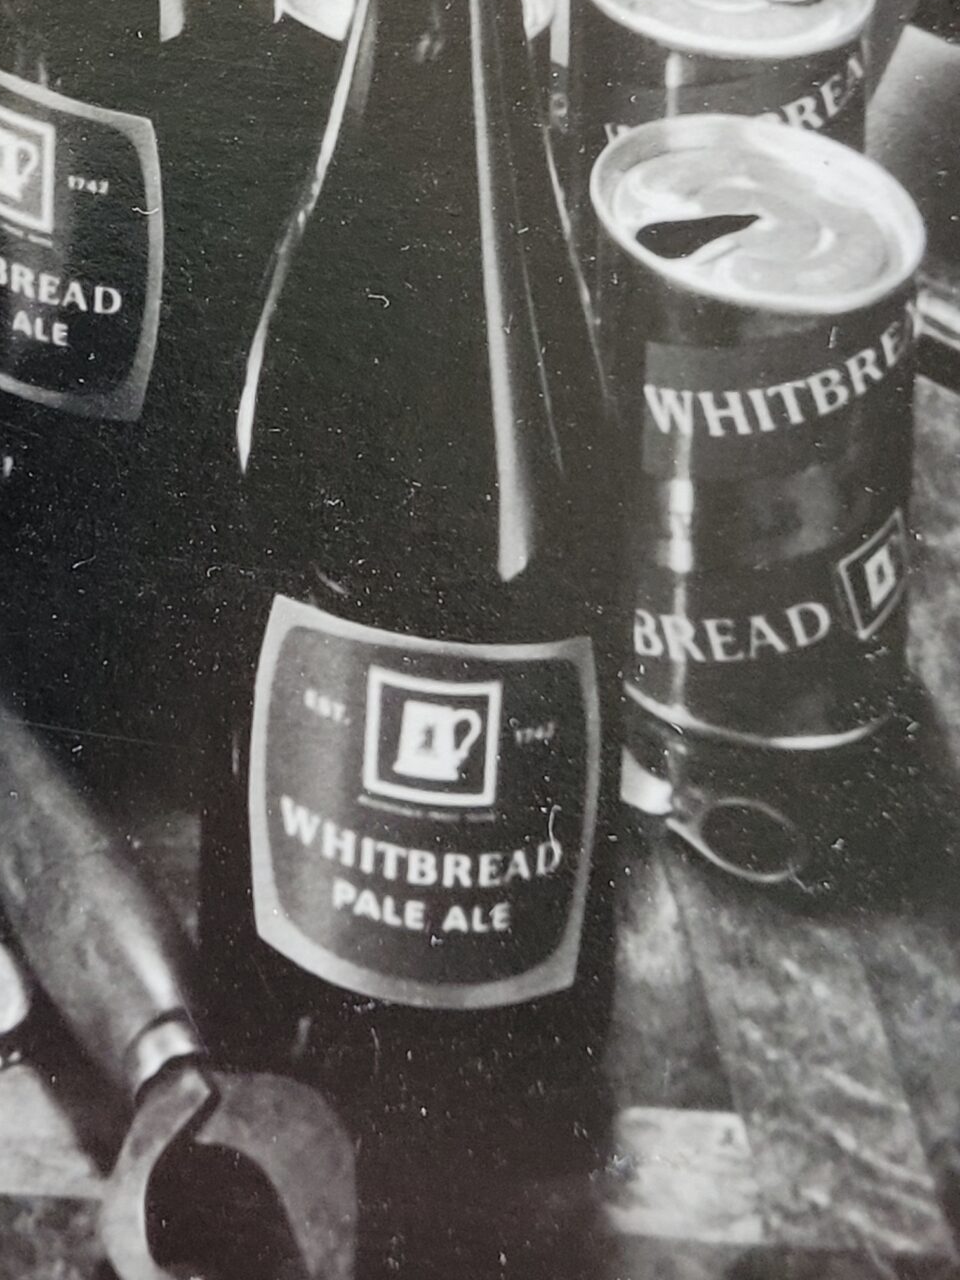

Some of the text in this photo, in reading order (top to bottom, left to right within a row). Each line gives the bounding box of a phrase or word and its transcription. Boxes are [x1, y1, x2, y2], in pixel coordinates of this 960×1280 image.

[12, 310, 69, 347] ALE
[633, 601, 832, 663] BREAD
[280, 794, 563, 888] WHITBREAD
[331, 878, 514, 934] PALE ALE
